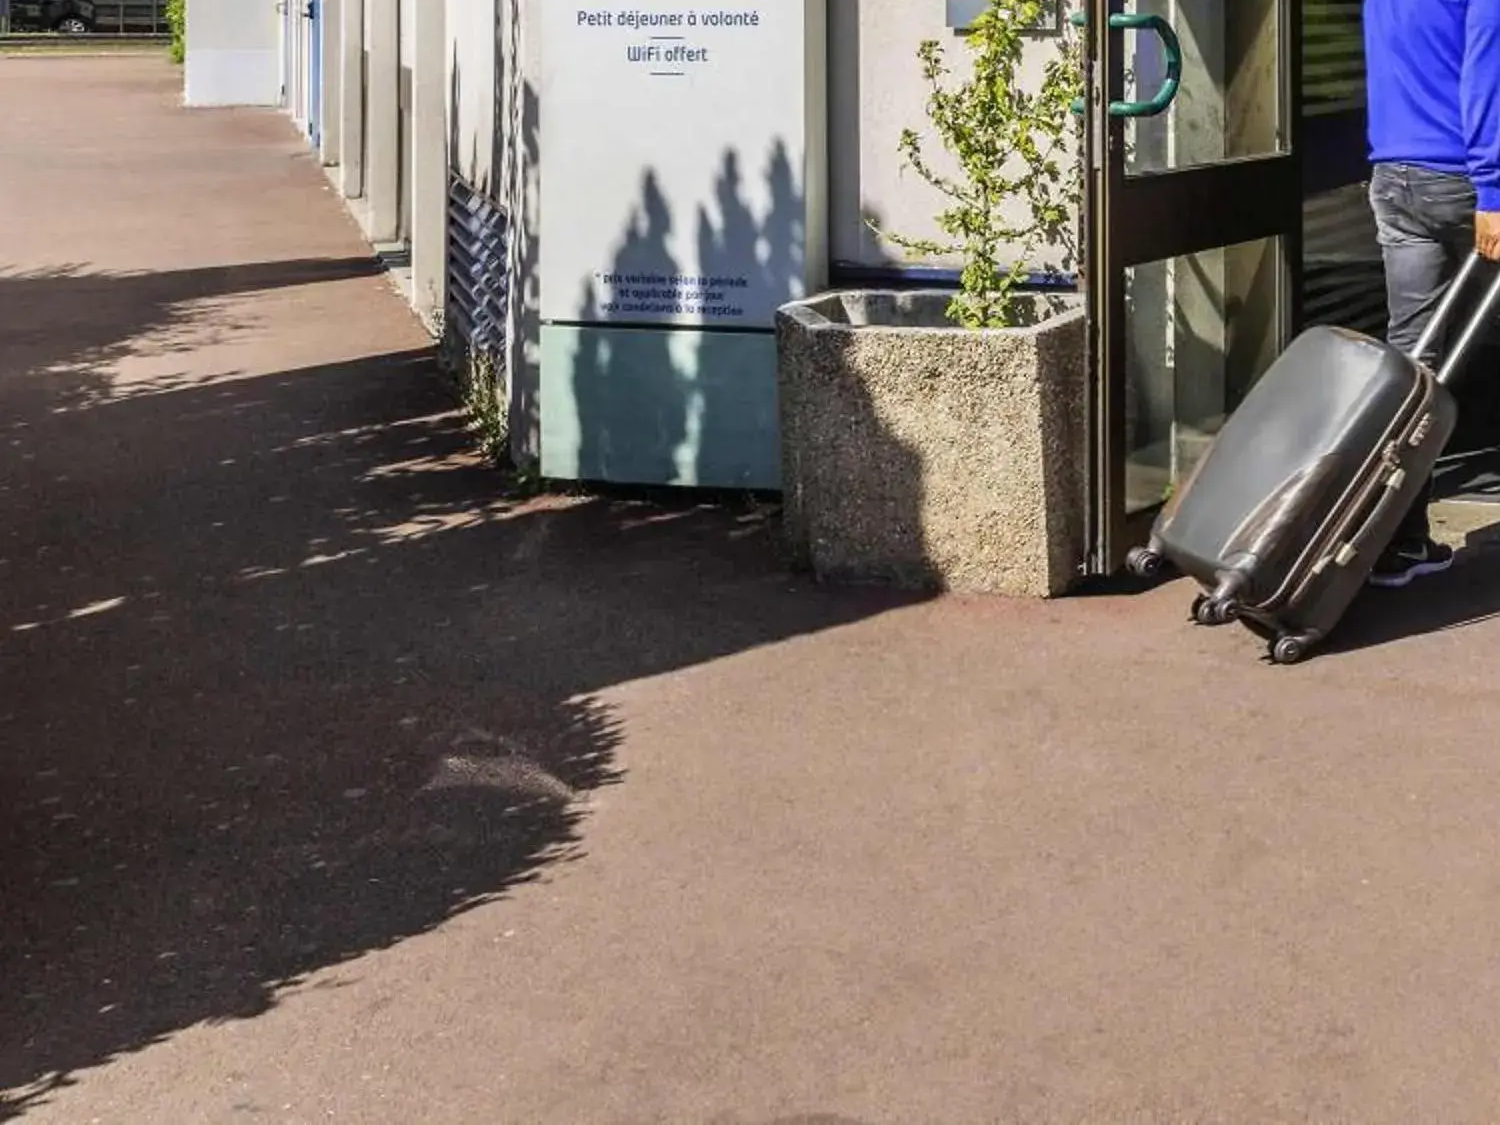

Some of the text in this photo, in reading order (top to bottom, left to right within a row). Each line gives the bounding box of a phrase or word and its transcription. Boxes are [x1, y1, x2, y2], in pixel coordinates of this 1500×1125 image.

[577, 9, 760, 29] Petit déjeuner à volonté
[627, 46, 708, 62] WiFi offert
